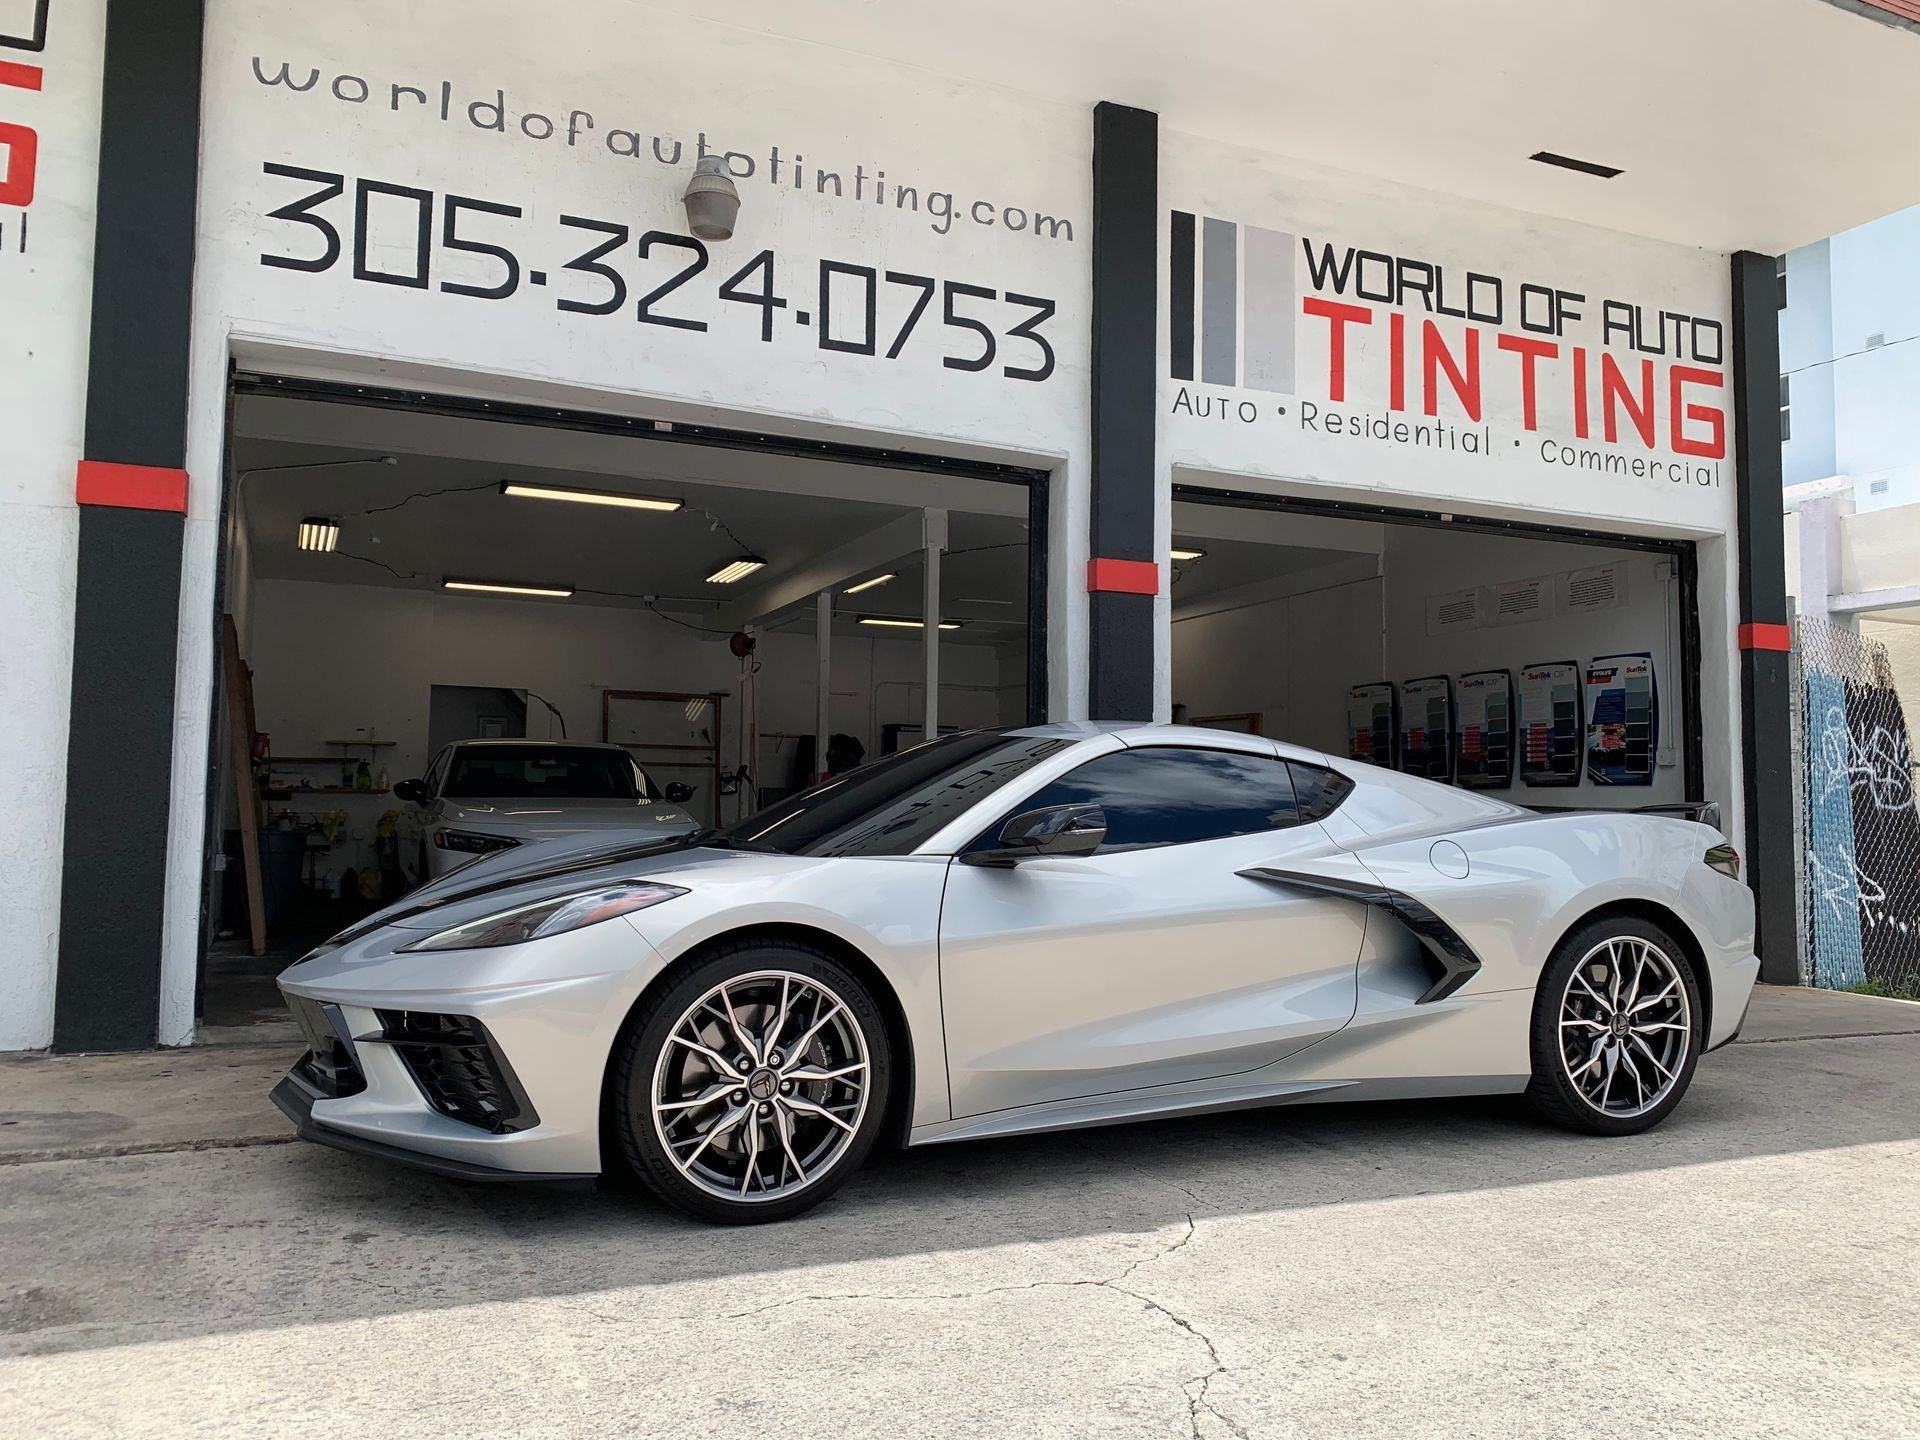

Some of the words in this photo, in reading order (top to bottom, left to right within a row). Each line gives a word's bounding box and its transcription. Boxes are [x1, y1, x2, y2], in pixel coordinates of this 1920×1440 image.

[252, 56, 1073, 242] worldofautotinting.com
[260, 161, 1056, 382] 305.324.0753
[1302, 237, 1503, 326] WORLD
[1520, 283, 1586, 337] OF
[1602, 299, 1723, 366] AUTO
[1301, 401, 1490, 457] Residential
[1540, 439, 1720, 489] Commercial
[1303, 296, 1726, 460] TINTING
[1527, 671, 1551, 681] SunTek
